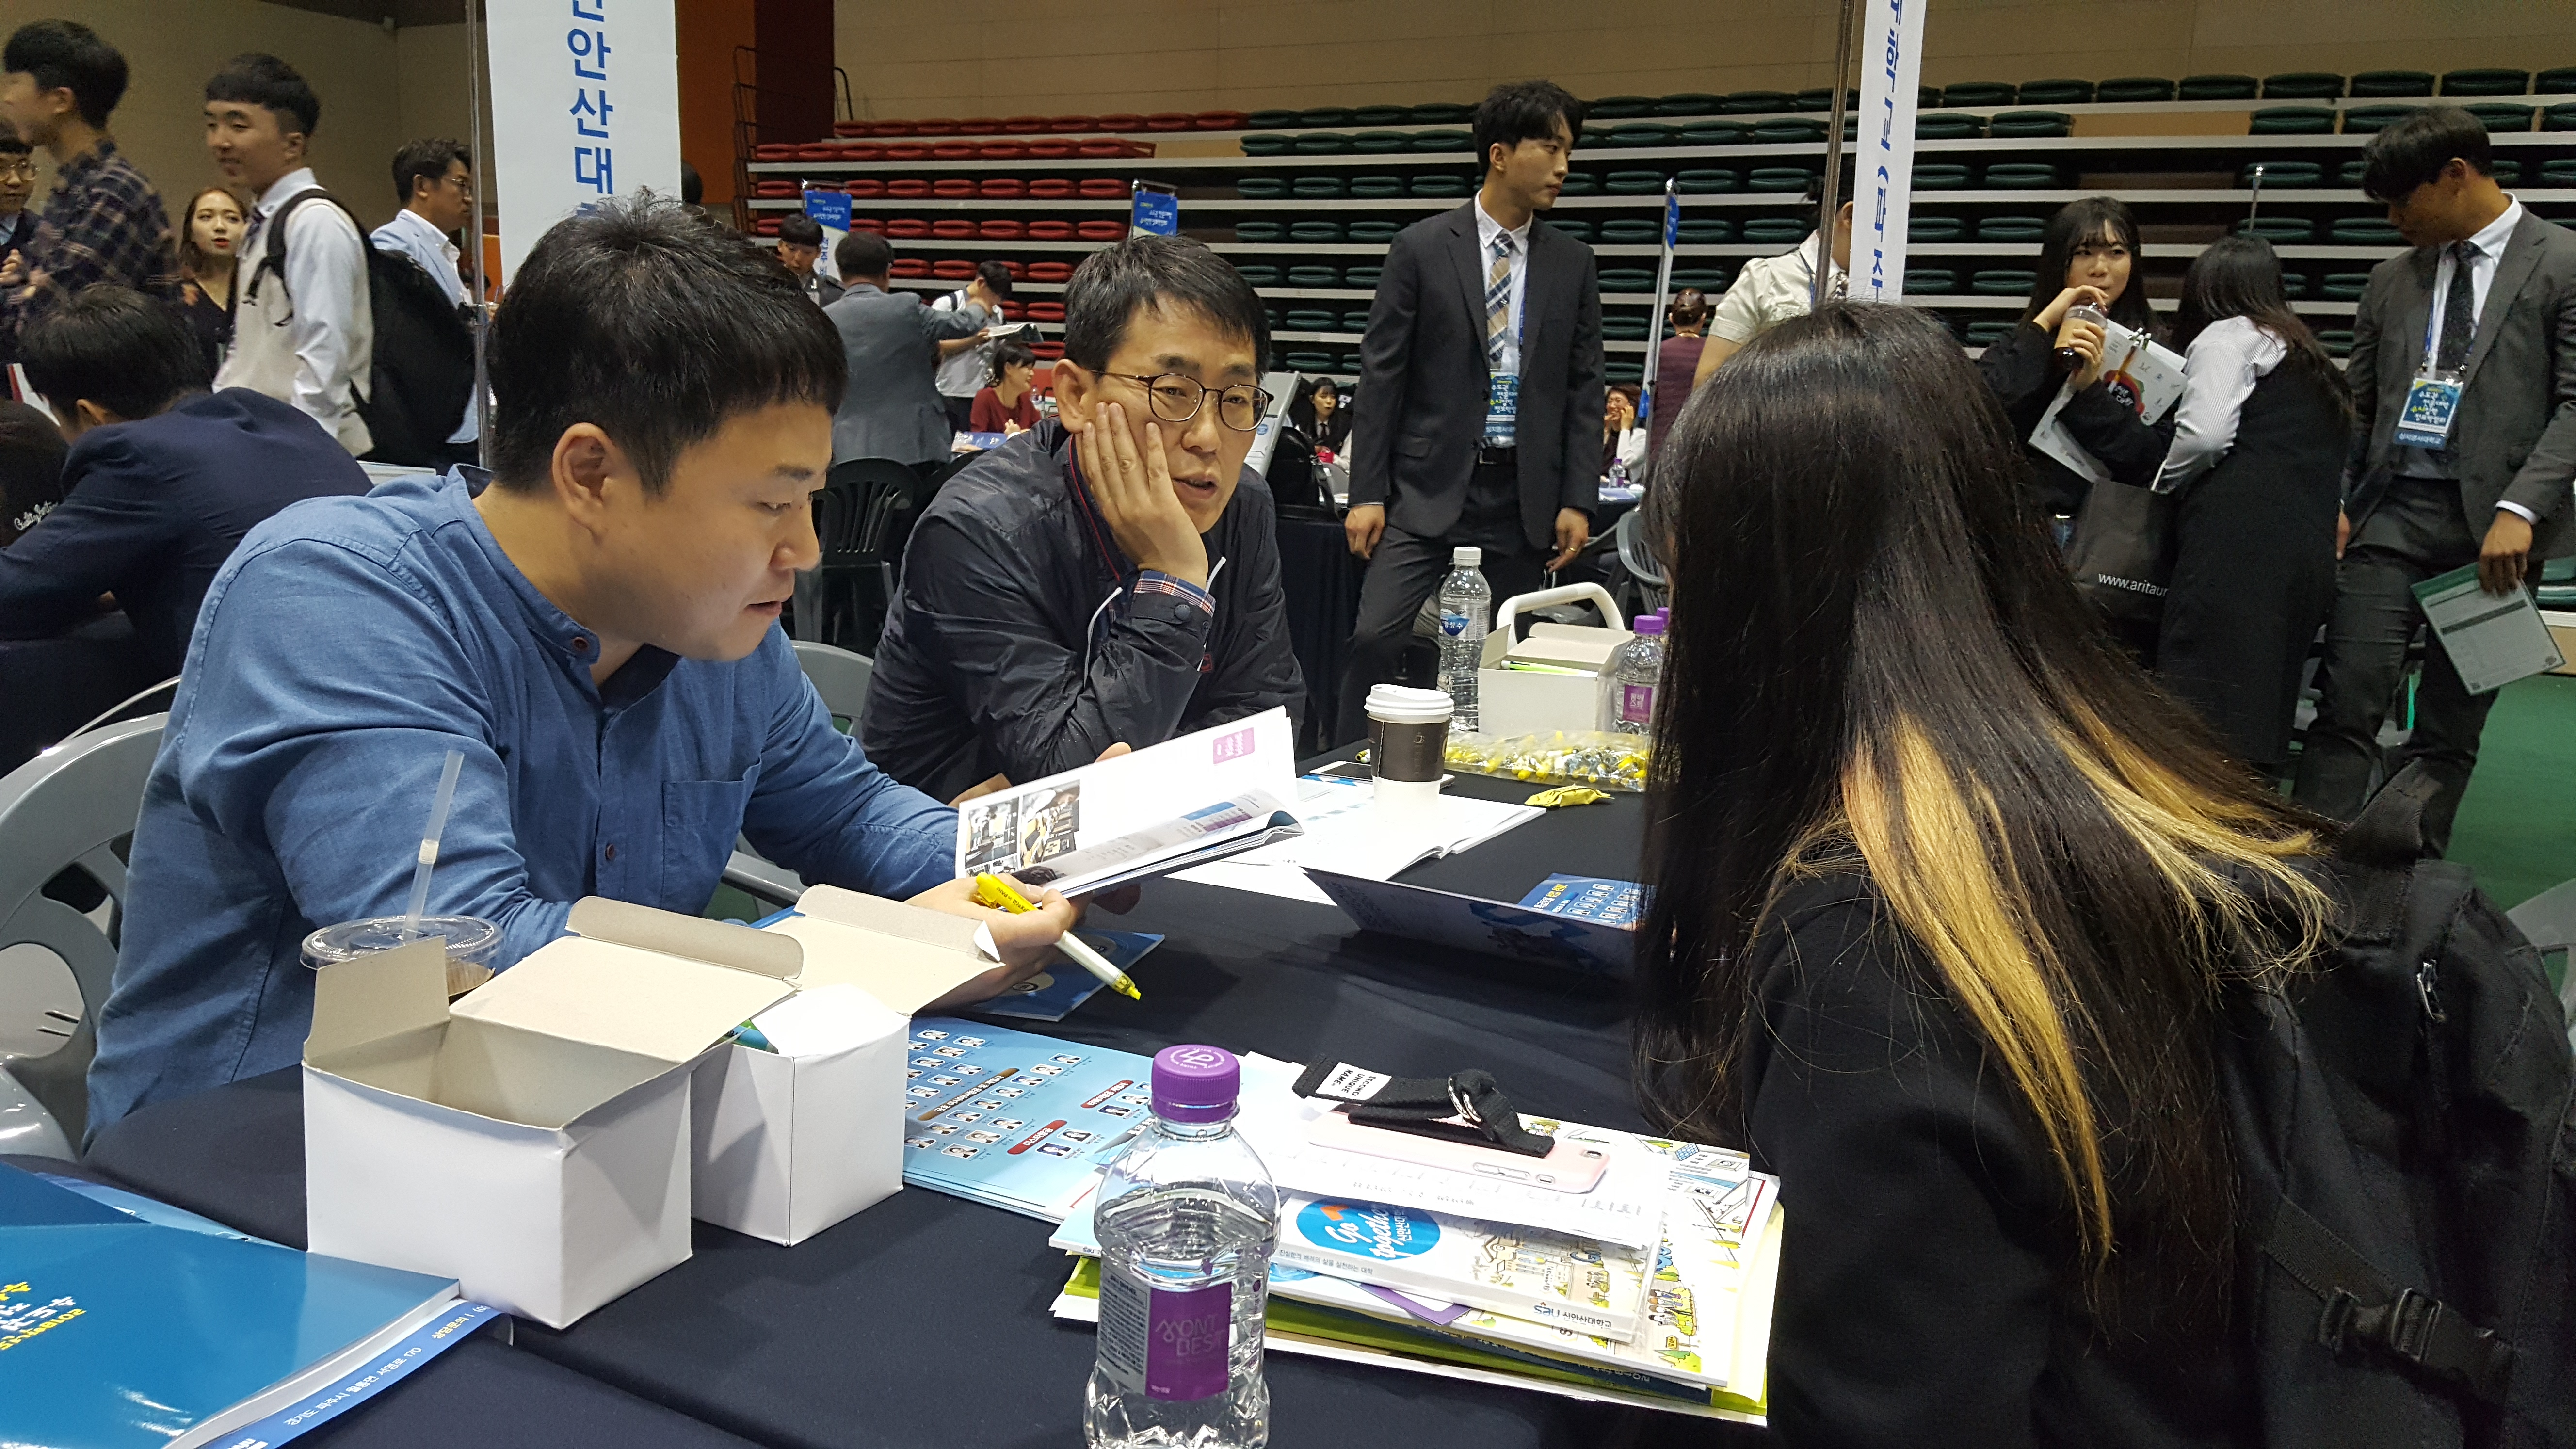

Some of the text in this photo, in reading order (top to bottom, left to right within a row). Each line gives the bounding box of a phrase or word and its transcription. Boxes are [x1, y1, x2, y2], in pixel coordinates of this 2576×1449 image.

[567, 0, 613, 216] 안산대
[1342, 1073, 1364, 1094] UNIQUE
[1352, 1075, 1377, 1097] SECOND
[1022, 1127, 1054, 1146] 이스타항공
[1325, 1222, 1373, 1243] Go
[1360, 1267, 1373, 1275] 대학
[1155, 1313, 1219, 1342] MONT
[1176, 1330, 1226, 1357] BEST
[283, 1407, 319, 1427] 경기도
[314, 1391, 348, 1412] 파주시
[376, 1357, 407, 1377] 서영로
[403, 1346, 423, 1359] 170
[431, 1316, 469, 1339] 상담문의
